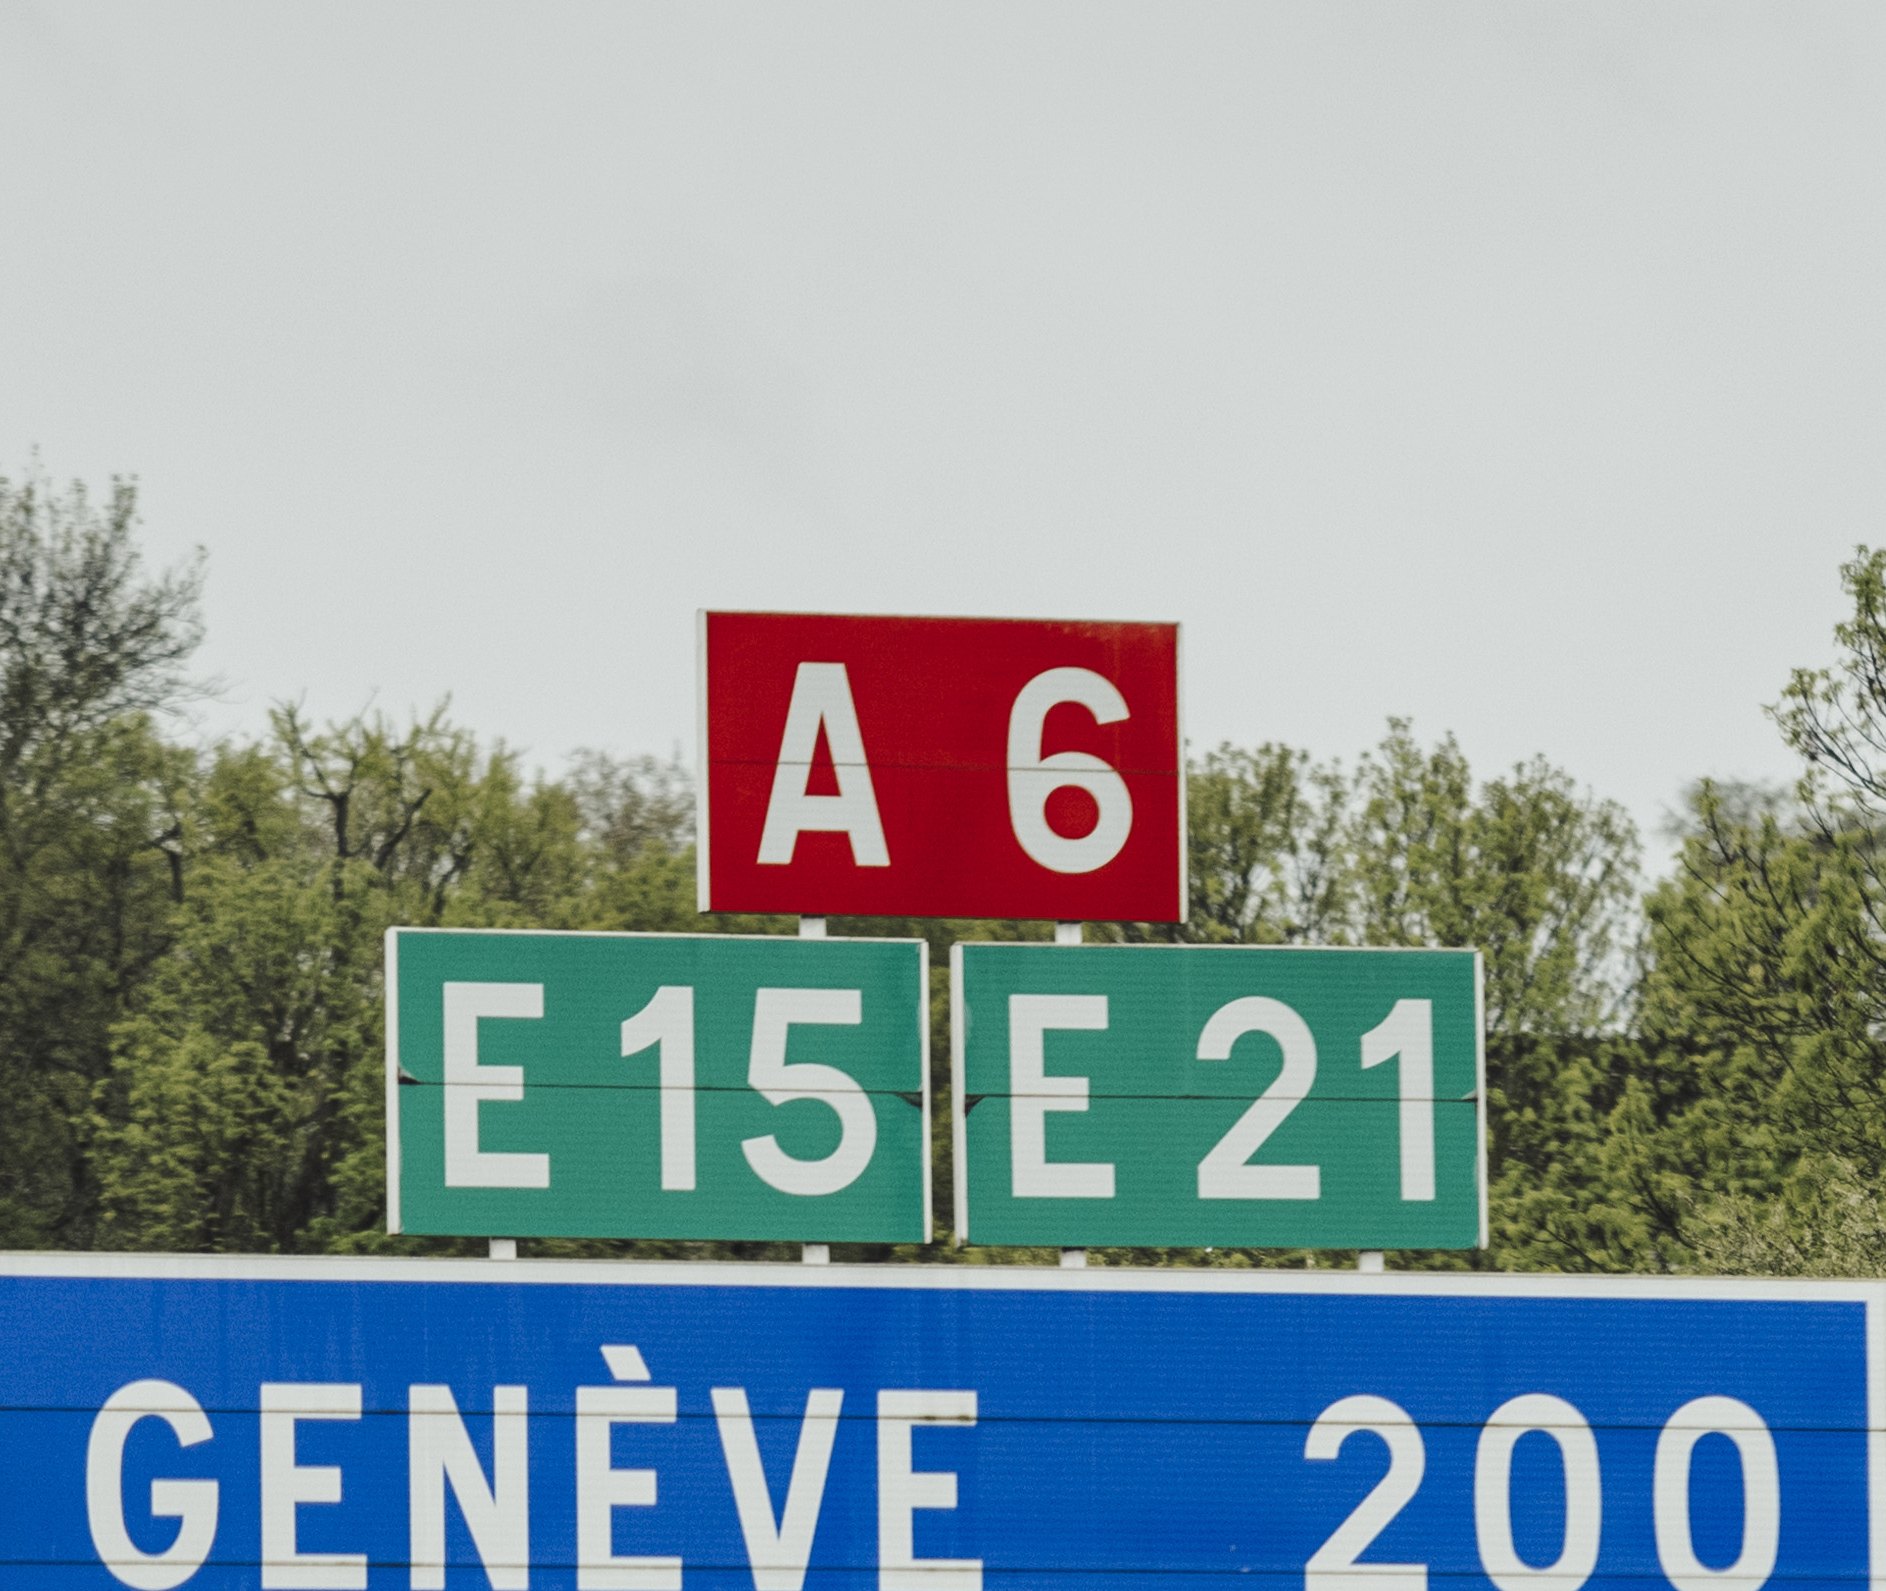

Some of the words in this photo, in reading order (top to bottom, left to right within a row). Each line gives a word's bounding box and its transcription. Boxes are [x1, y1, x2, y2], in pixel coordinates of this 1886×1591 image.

[756, 661, 891, 867] A
[1007, 666, 1133, 874] 6
[442, 980, 551, 1190] E
[620, 985, 878, 1197] 15
[1008, 993, 1116, 1199] E
[1195, 995, 1436, 1202] 21
